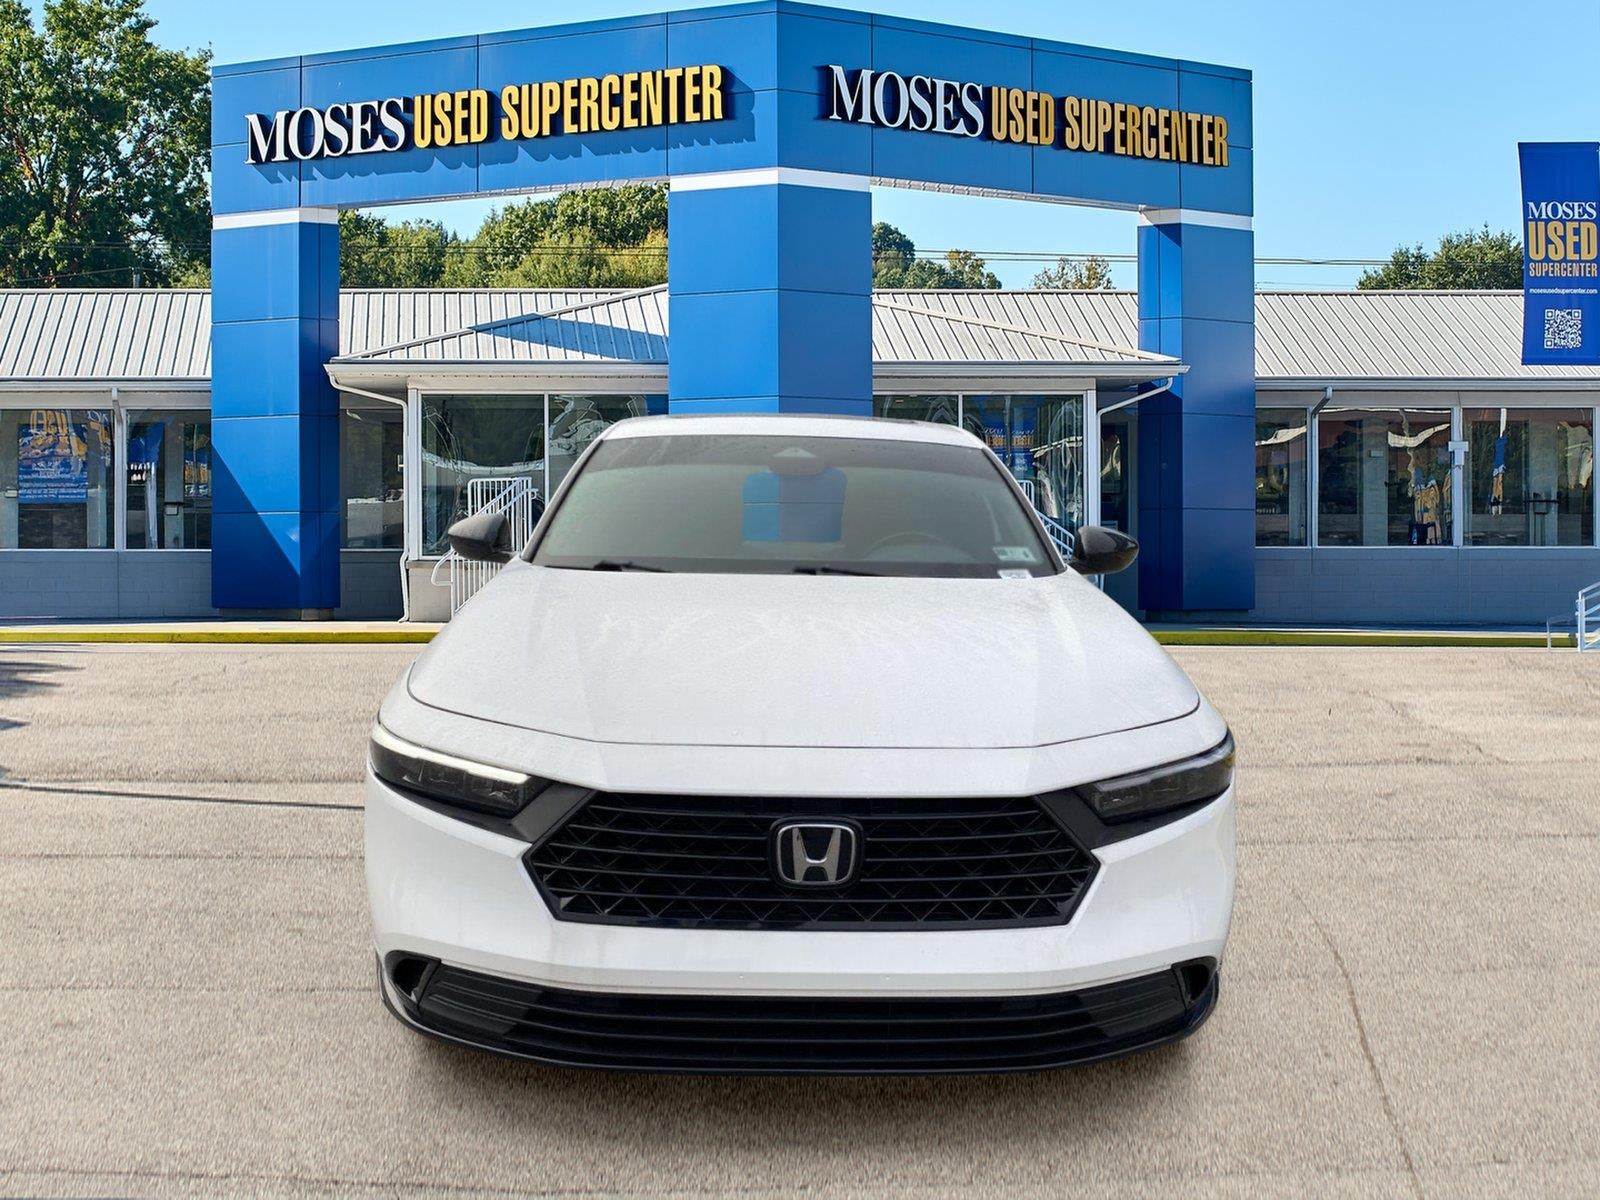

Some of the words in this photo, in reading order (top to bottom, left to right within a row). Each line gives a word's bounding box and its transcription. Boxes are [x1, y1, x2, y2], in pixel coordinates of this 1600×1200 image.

[245, 97, 407, 165] MOSES
[413, 88, 489, 150] USED
[500, 63, 724, 142] SUPERCENTER
[828, 64, 985, 138] MOSES
[991, 86, 1056, 146] USED
[1064, 96, 1230, 167] SUPERCENTER
[1527, 201, 1597, 220] MOSES
[1528, 221, 1598, 261] USED
[1529, 262, 1598, 278] SUPERCENTER
